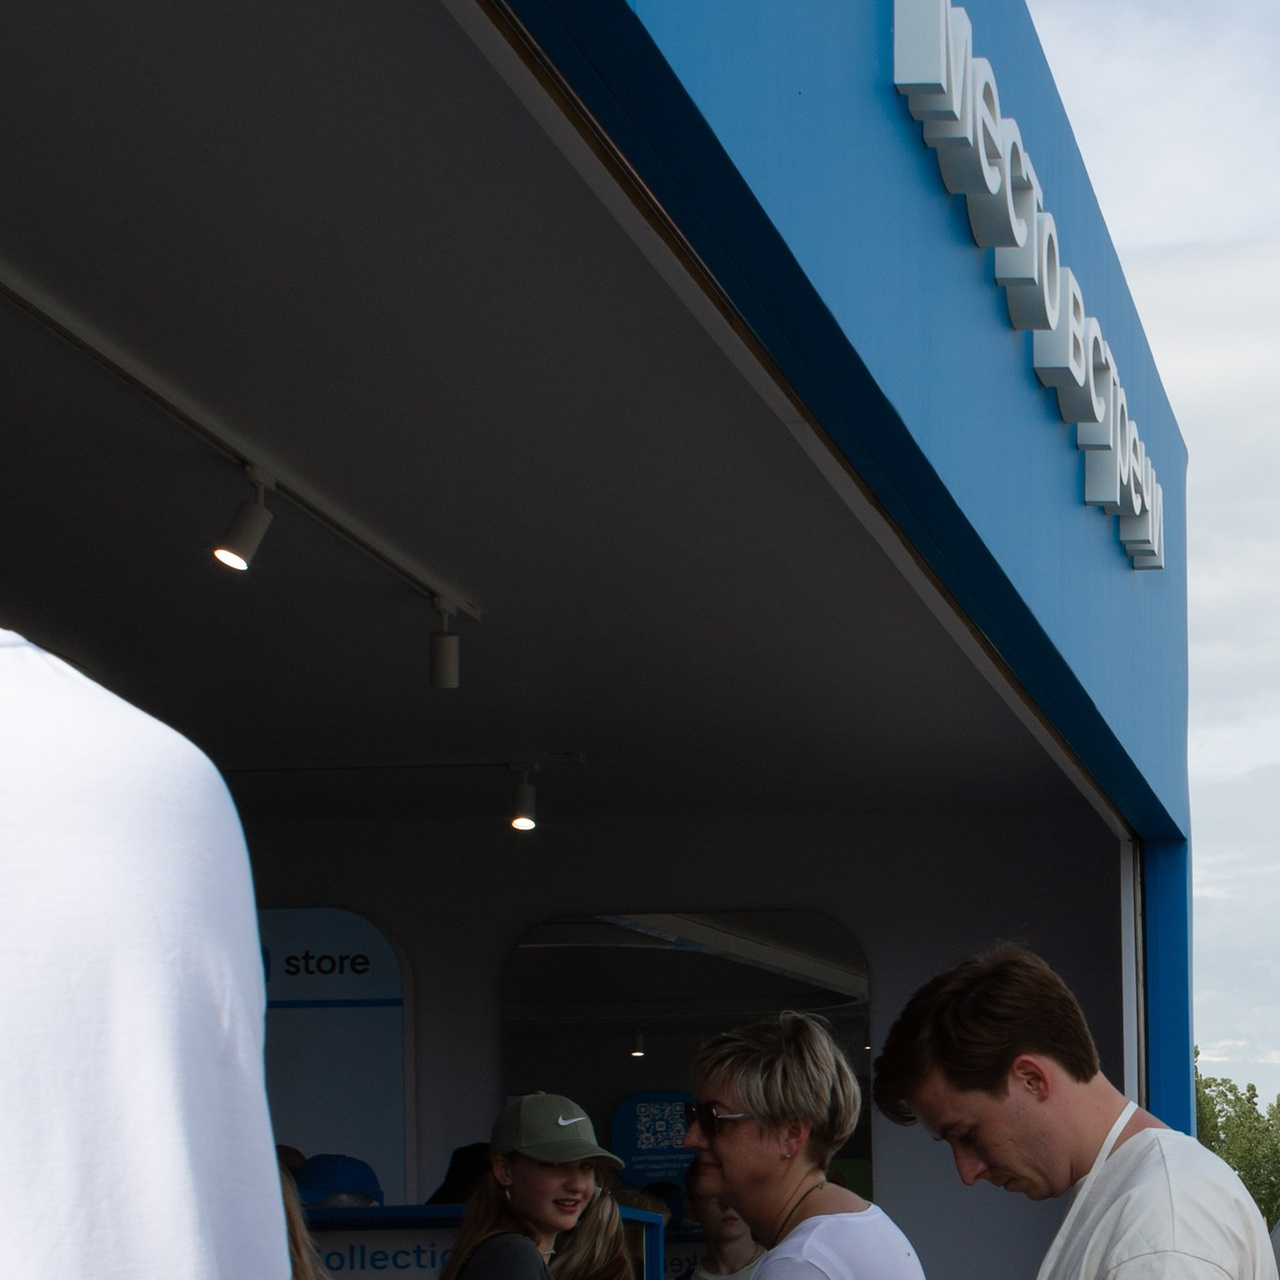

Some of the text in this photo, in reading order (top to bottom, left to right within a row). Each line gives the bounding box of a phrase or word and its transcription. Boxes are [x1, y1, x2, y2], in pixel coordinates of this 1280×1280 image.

[1033, 266, 1165, 571] встречи
[285, 950, 371, 976] store
[316, 1243, 453, 1270] ollecti
